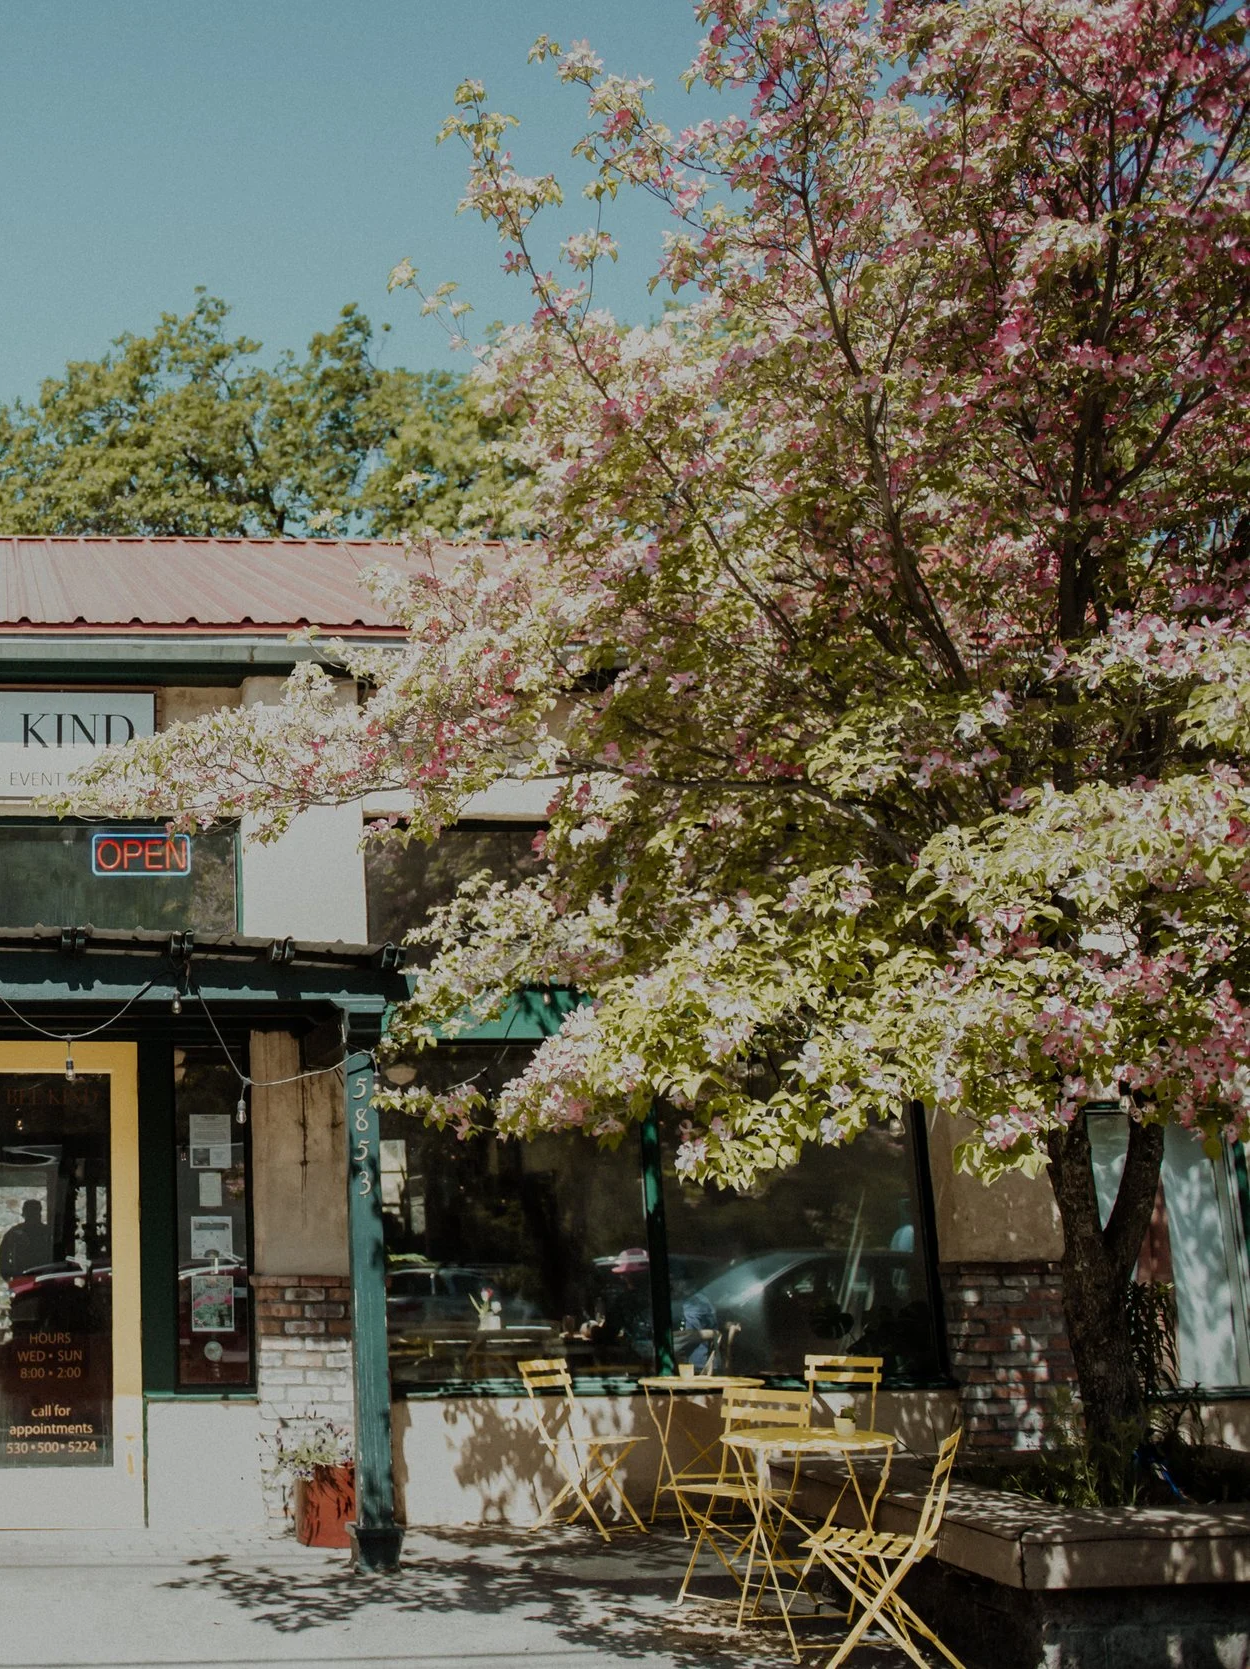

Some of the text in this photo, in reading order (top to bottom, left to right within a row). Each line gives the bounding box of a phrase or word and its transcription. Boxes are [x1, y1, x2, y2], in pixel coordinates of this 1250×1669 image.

[20, 713, 135, 749] KIND
[10, 771, 63, 787] EVENT
[97, 839, 187, 871] OPEN
[30, 1332, 71, 1344] HOURS
[17, 1350, 82, 1362] WED SUN
[20, 1366, 81, 1379] 8:00 2:00
[31, 1404, 71, 1417] call for
[9, 1422, 93, 1438] appointments
